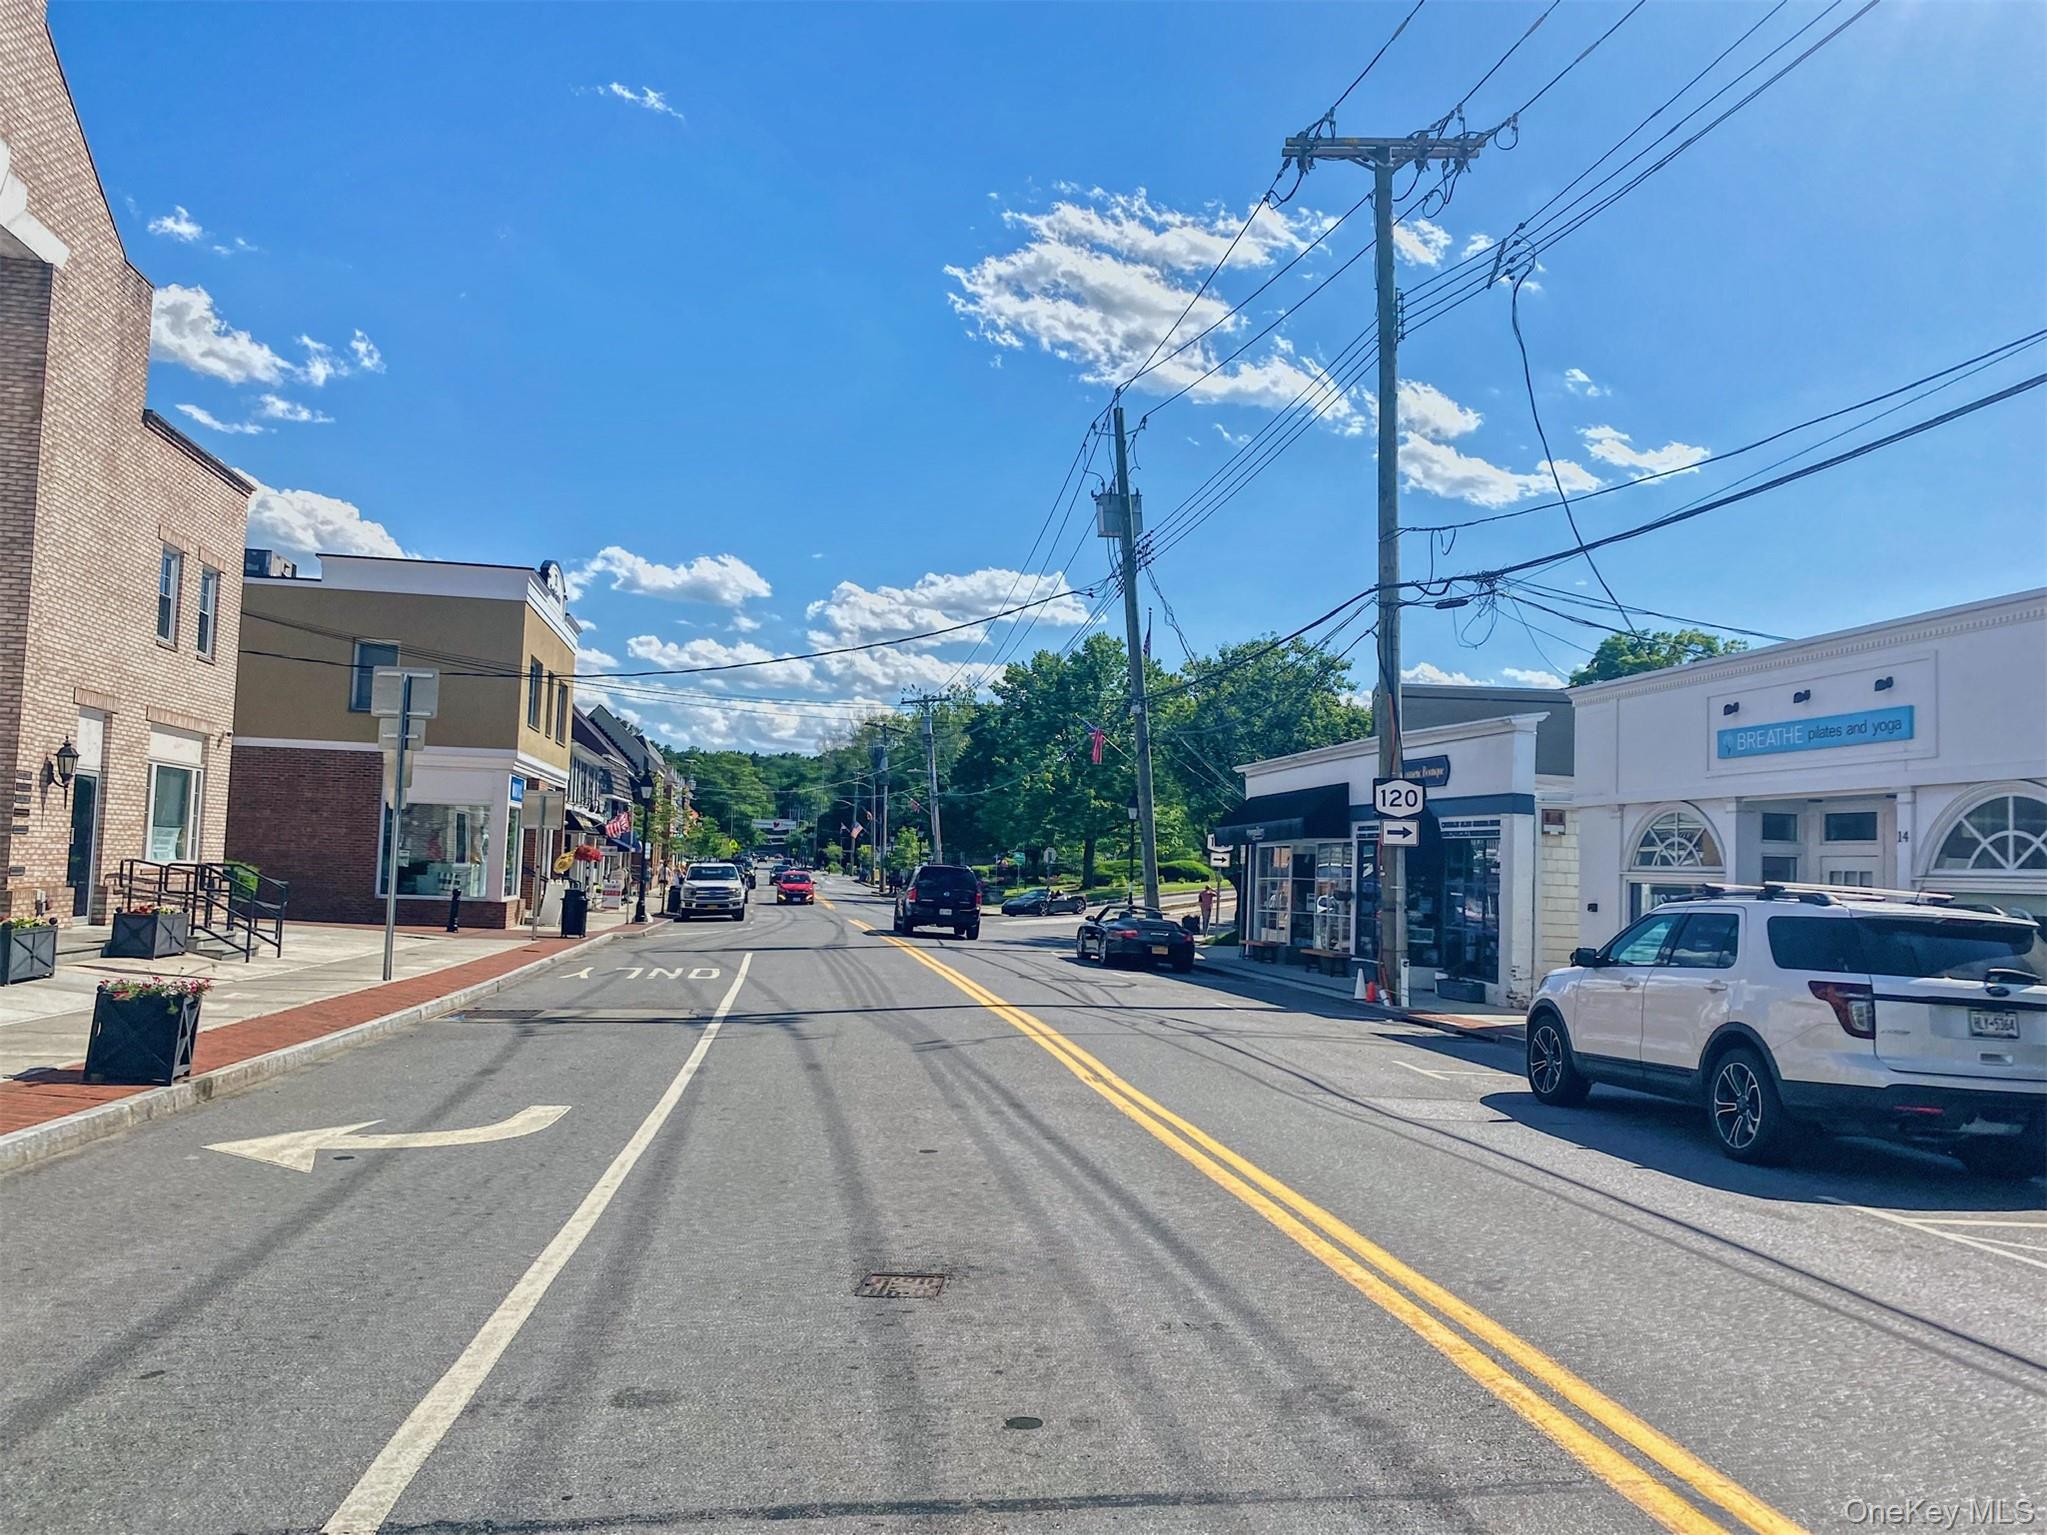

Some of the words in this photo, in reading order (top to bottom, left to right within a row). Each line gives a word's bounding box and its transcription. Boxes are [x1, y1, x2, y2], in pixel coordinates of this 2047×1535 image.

[1737, 726, 1803, 750] BREATHE
[1808, 725, 1842, 742] pilates
[1846, 721, 1868, 736] and
[1871, 719, 1903, 736] yoga
[1381, 789, 1418, 807] 120
[1897, 830, 1909, 843] 14
[560, 967, 720, 979] ONLY
